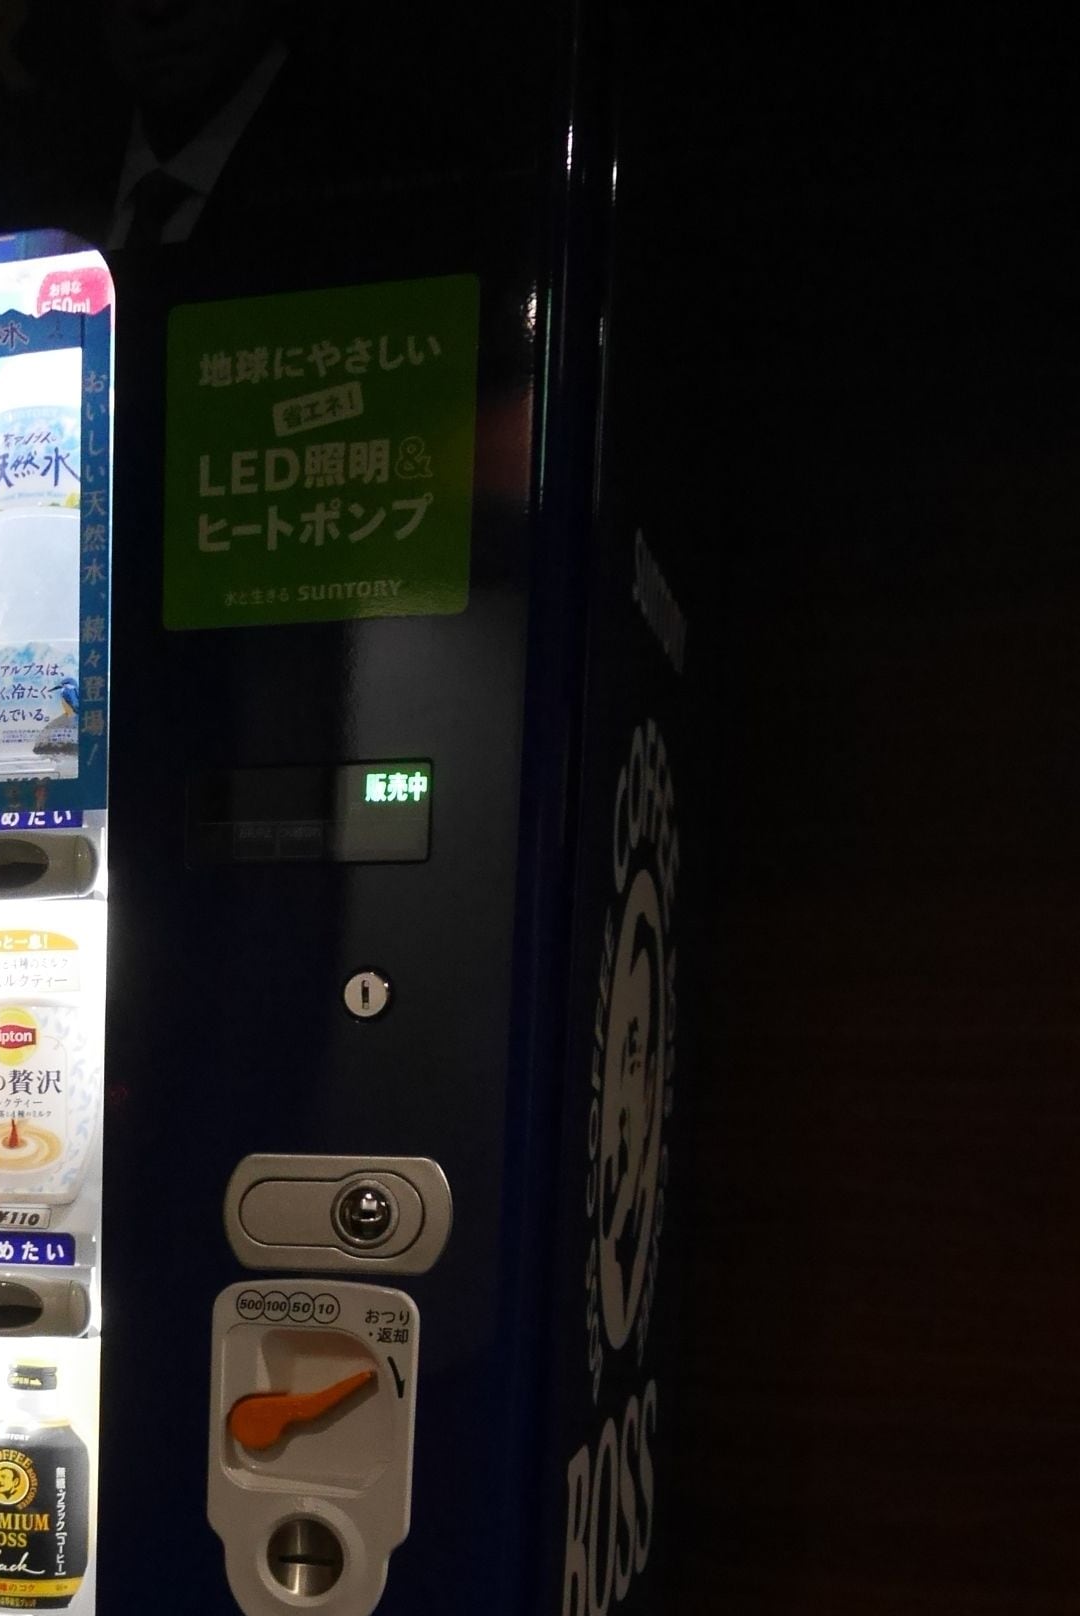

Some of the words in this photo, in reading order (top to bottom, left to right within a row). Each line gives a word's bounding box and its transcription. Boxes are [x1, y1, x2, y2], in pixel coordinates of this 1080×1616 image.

[199, 335, 442, 387] 地球にやさしい
[198, 491, 435, 552] ヒートポンプ
[365, 772, 428, 802] 販売中
[239, 1299, 264, 1311] 500
[266, 1300, 288, 1312] 100
[291, 1302, 312, 1314] 50
[318, 1303, 335, 1315] 10
[364, 1309, 410, 1326] おつり
